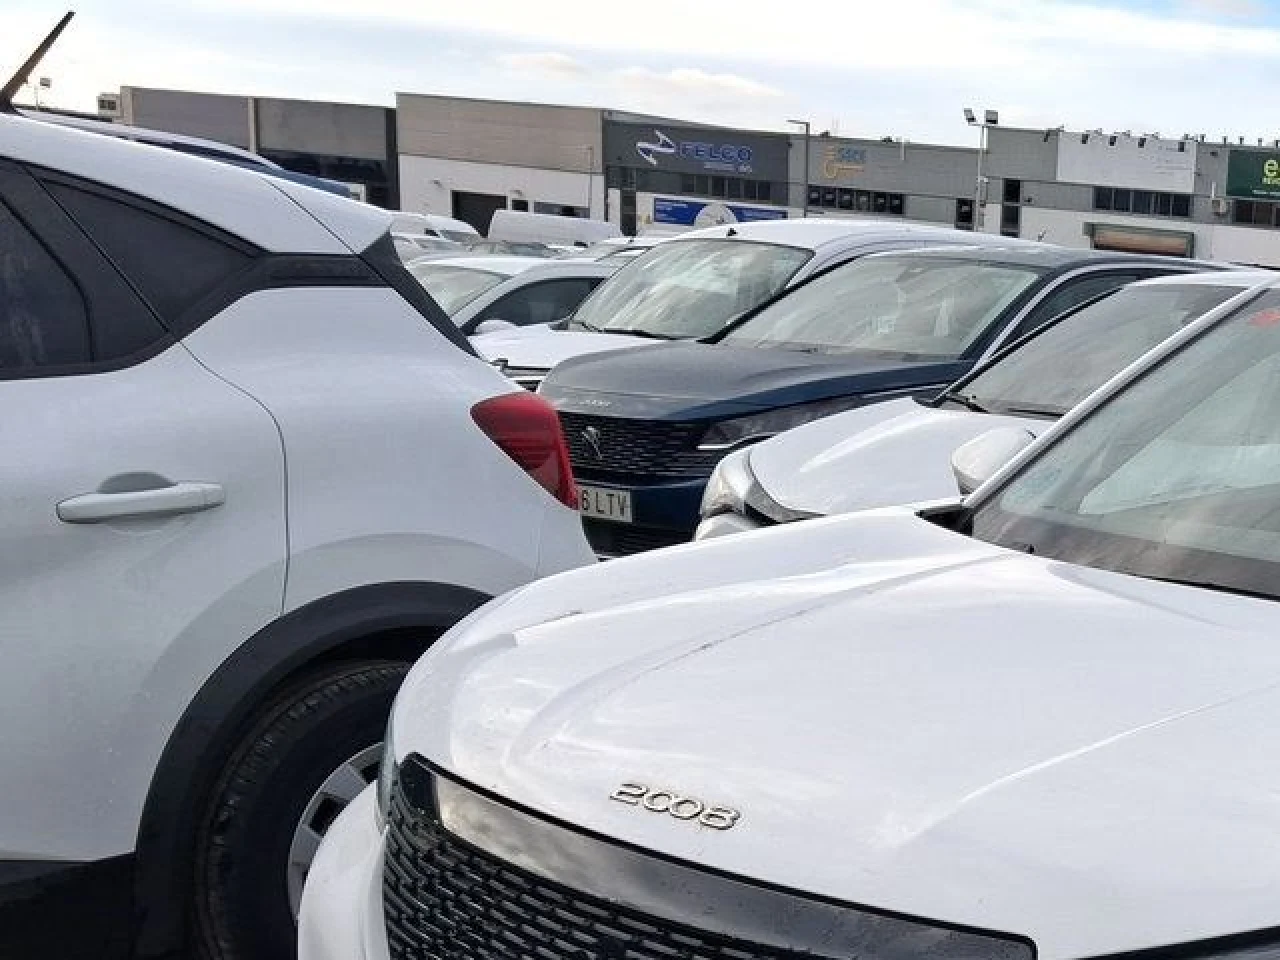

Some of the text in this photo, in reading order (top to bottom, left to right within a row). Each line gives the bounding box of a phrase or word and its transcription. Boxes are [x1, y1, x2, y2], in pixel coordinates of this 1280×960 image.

[680, 142, 752, 161] FELCO
[595, 491, 627, 516] LTV
[609, 783, 741, 830] 2008
